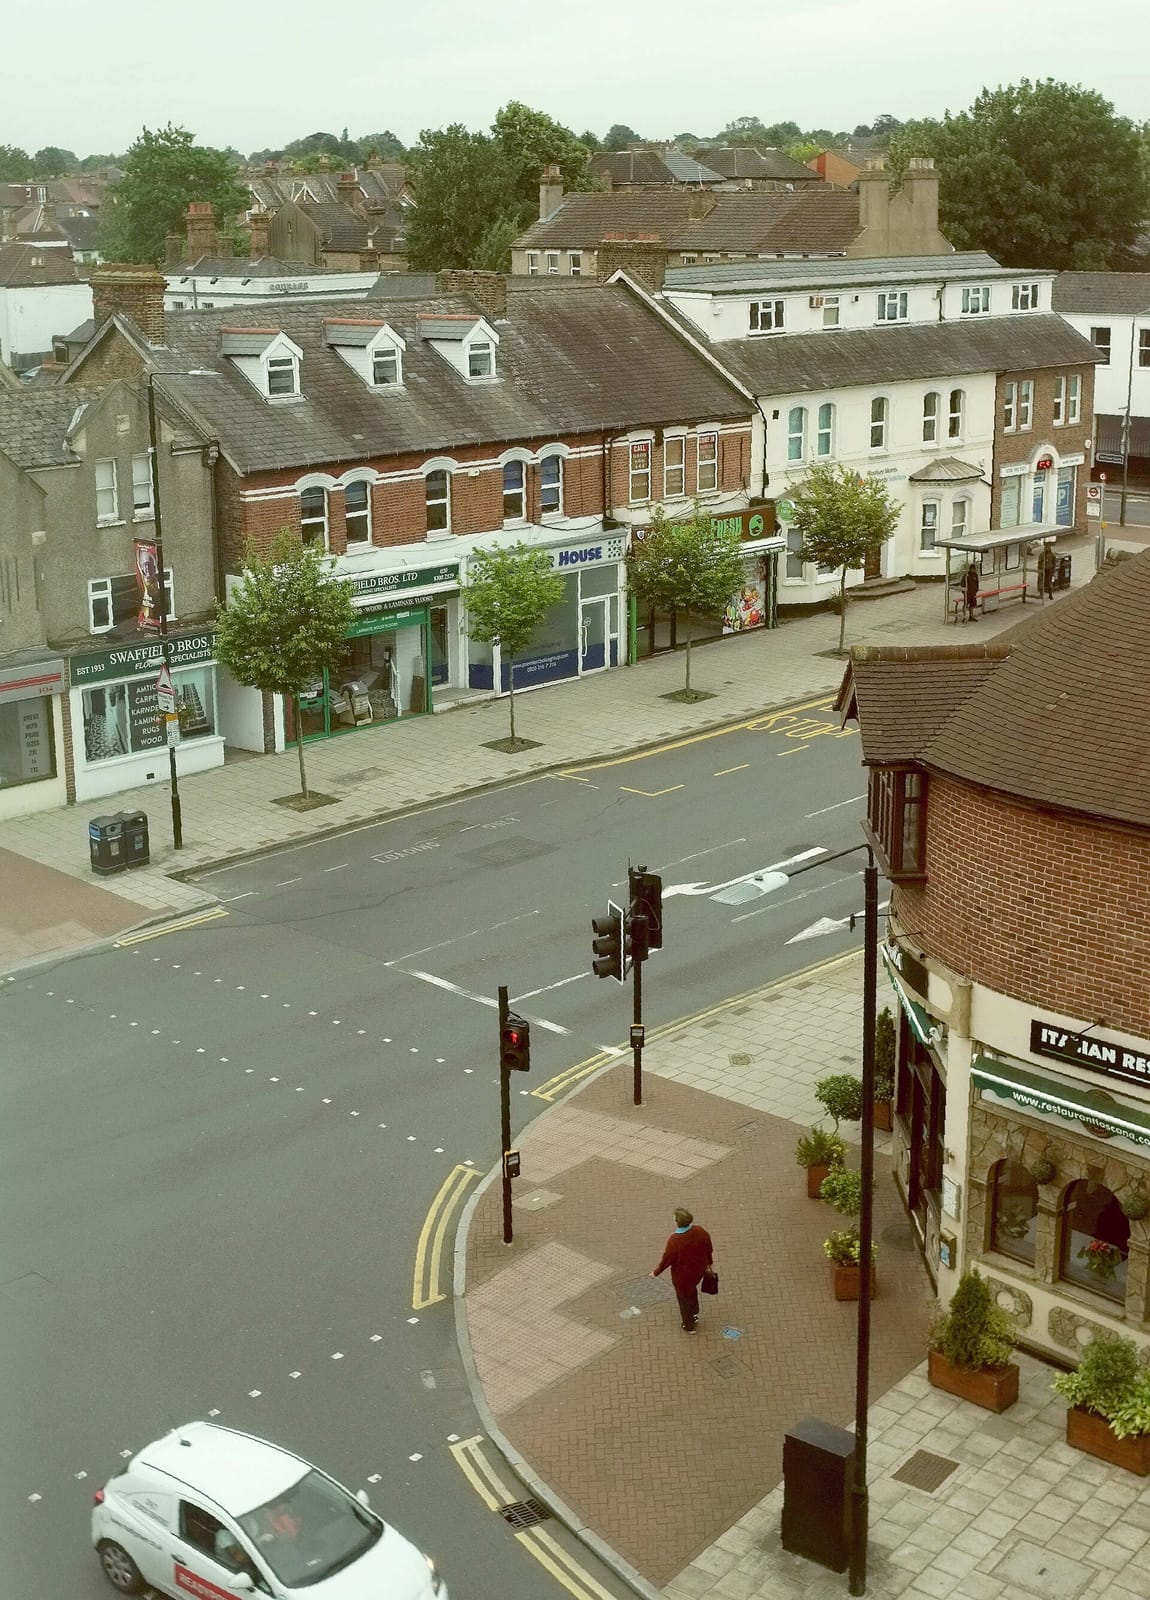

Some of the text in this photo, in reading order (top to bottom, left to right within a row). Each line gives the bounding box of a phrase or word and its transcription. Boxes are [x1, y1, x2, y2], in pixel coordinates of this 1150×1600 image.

[558, 546, 602, 566] HOUSE
[378, 575, 400, 586] BROS.
[402, 572, 418, 582] LTD
[176, 636, 210, 653] BROS.
[170, 648, 211, 664] SPECIALISTS
[76, 663, 105, 676] EST 1933
[136, 683, 157, 694] AMTIC
[135, 694, 158, 704] CARPE
[131, 704, 159, 716] KARNDE
[134, 716, 160, 726] LAMINA
[746, 715, 853, 740] STOP
[142, 725, 160, 735] RUGS
[140, 735, 163, 745] WOOD
[373, 841, 441, 864] LOADING
[1041, 1028, 1117, 1064] ITAIAN
